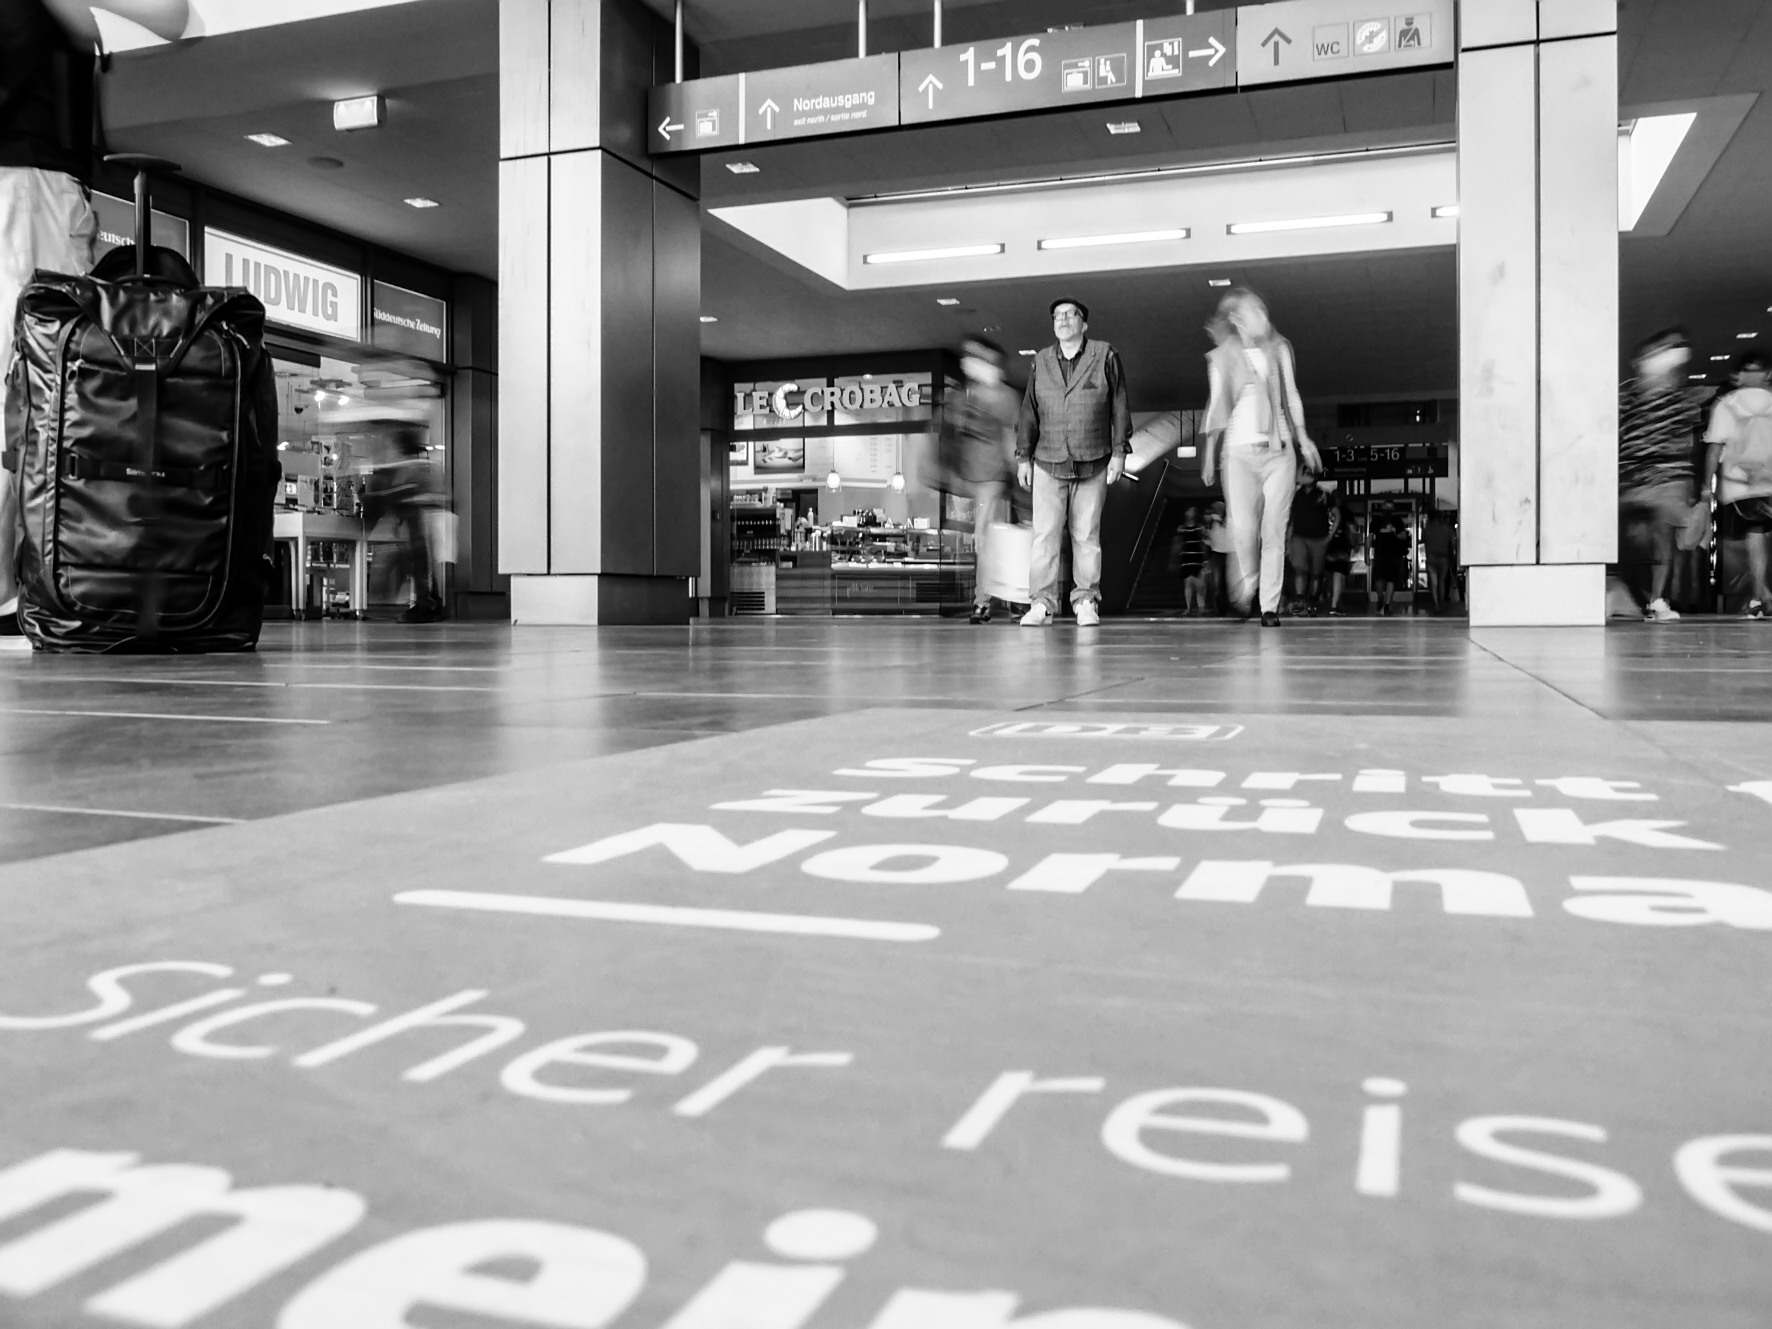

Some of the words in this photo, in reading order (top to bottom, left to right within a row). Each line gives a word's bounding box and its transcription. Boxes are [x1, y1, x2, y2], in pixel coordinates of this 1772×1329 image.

[959, 38, 1043, 87] 1-16
[1316, 41, 1340, 56] WC
[793, 91, 875, 112] Nordausgang
[793, 117, 806, 126] exit
[807, 114, 825, 123] north
[830, 112, 850, 121] sortie
[851, 109, 867, 118] nord
[415, 318, 441, 339] Zeitung
[736, 391, 770, 415] LE
[804, 382, 920, 412] CROBAG
[1334, 449, 1355, 462] 1-3
[1370, 447, 1400, 461] 5-16
[831, 756, 1661, 803] Schritt
[709, 788, 1725, 851] zurück
[541, 822, 1772, 929] Norma
[0, 960, 851, 1116] Sicher
[0, 1149, 1183, 1329] mei
